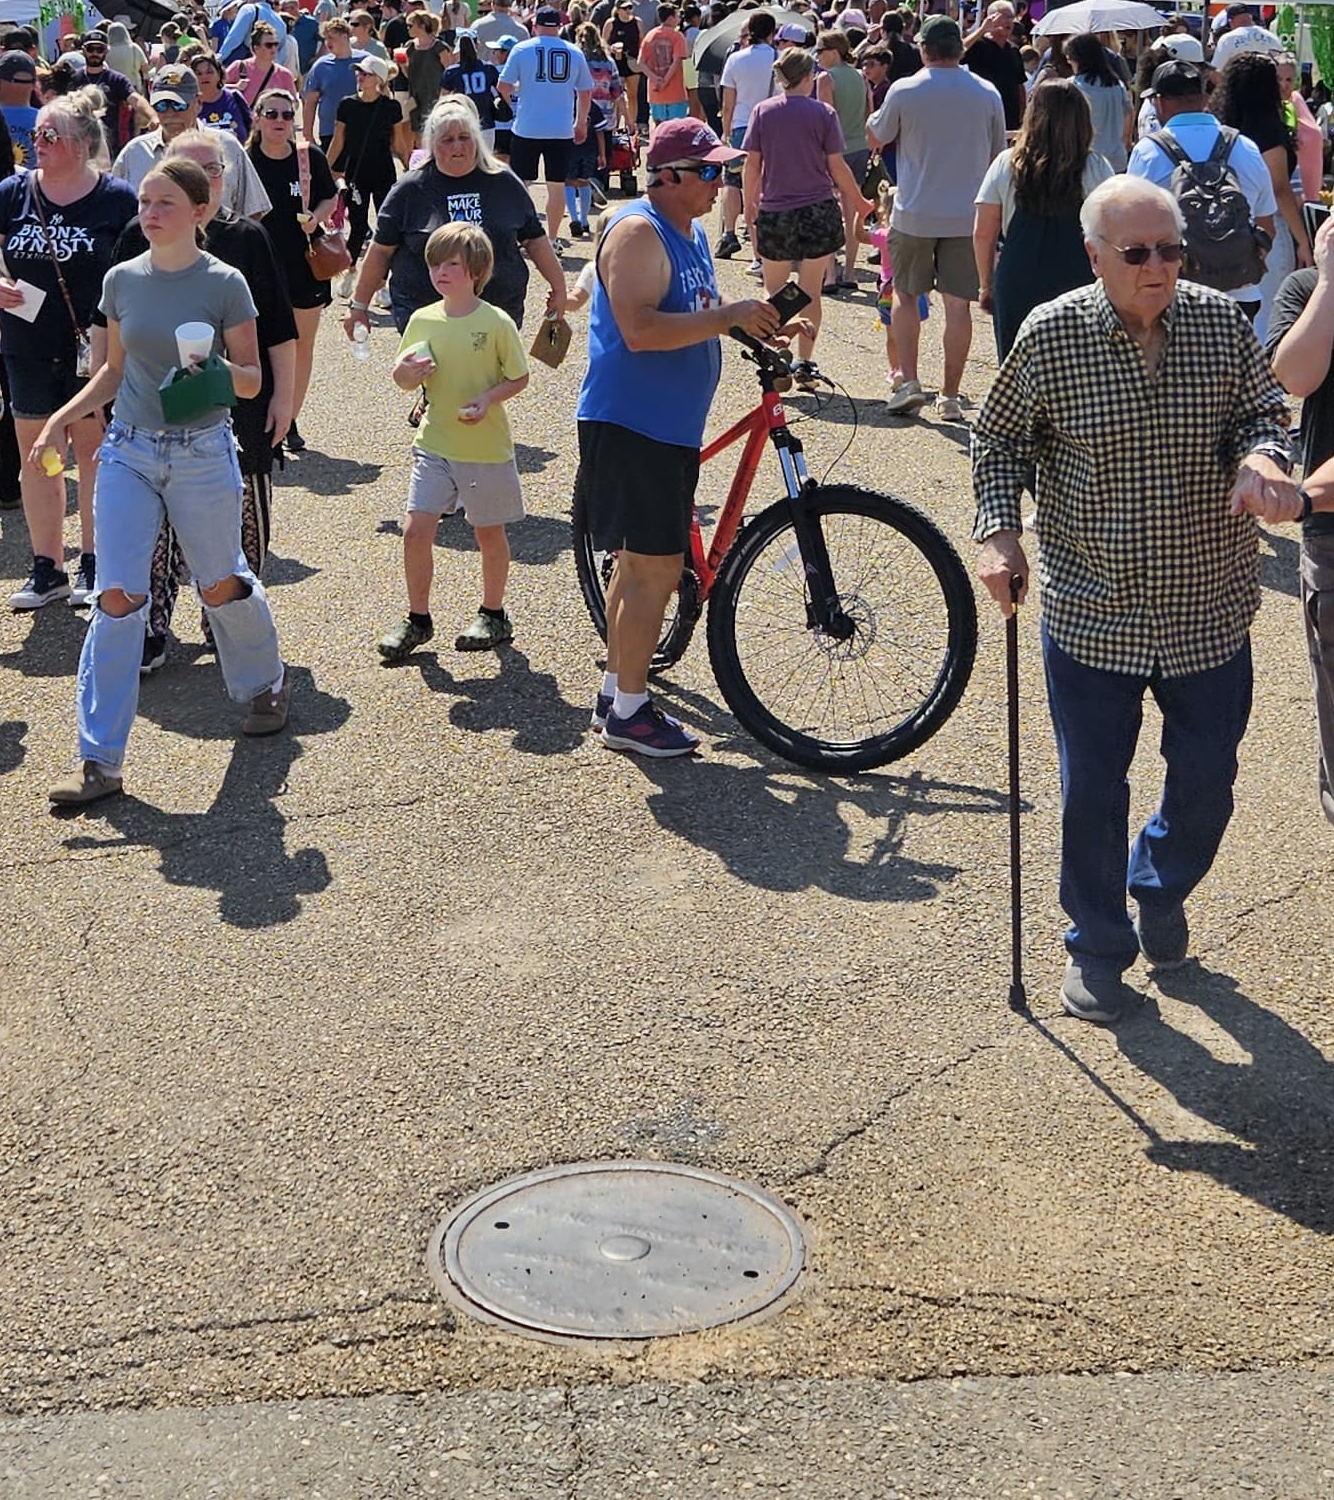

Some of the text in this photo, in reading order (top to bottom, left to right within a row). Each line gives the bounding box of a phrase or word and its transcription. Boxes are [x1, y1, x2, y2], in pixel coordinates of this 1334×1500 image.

[535, 46, 571, 83] 10
[462, 71, 486, 95] 10
[448, 198, 481, 211] MAKE
[17, 224, 88, 239] BRONX
[7, 235, 95, 262] DYNASTY
